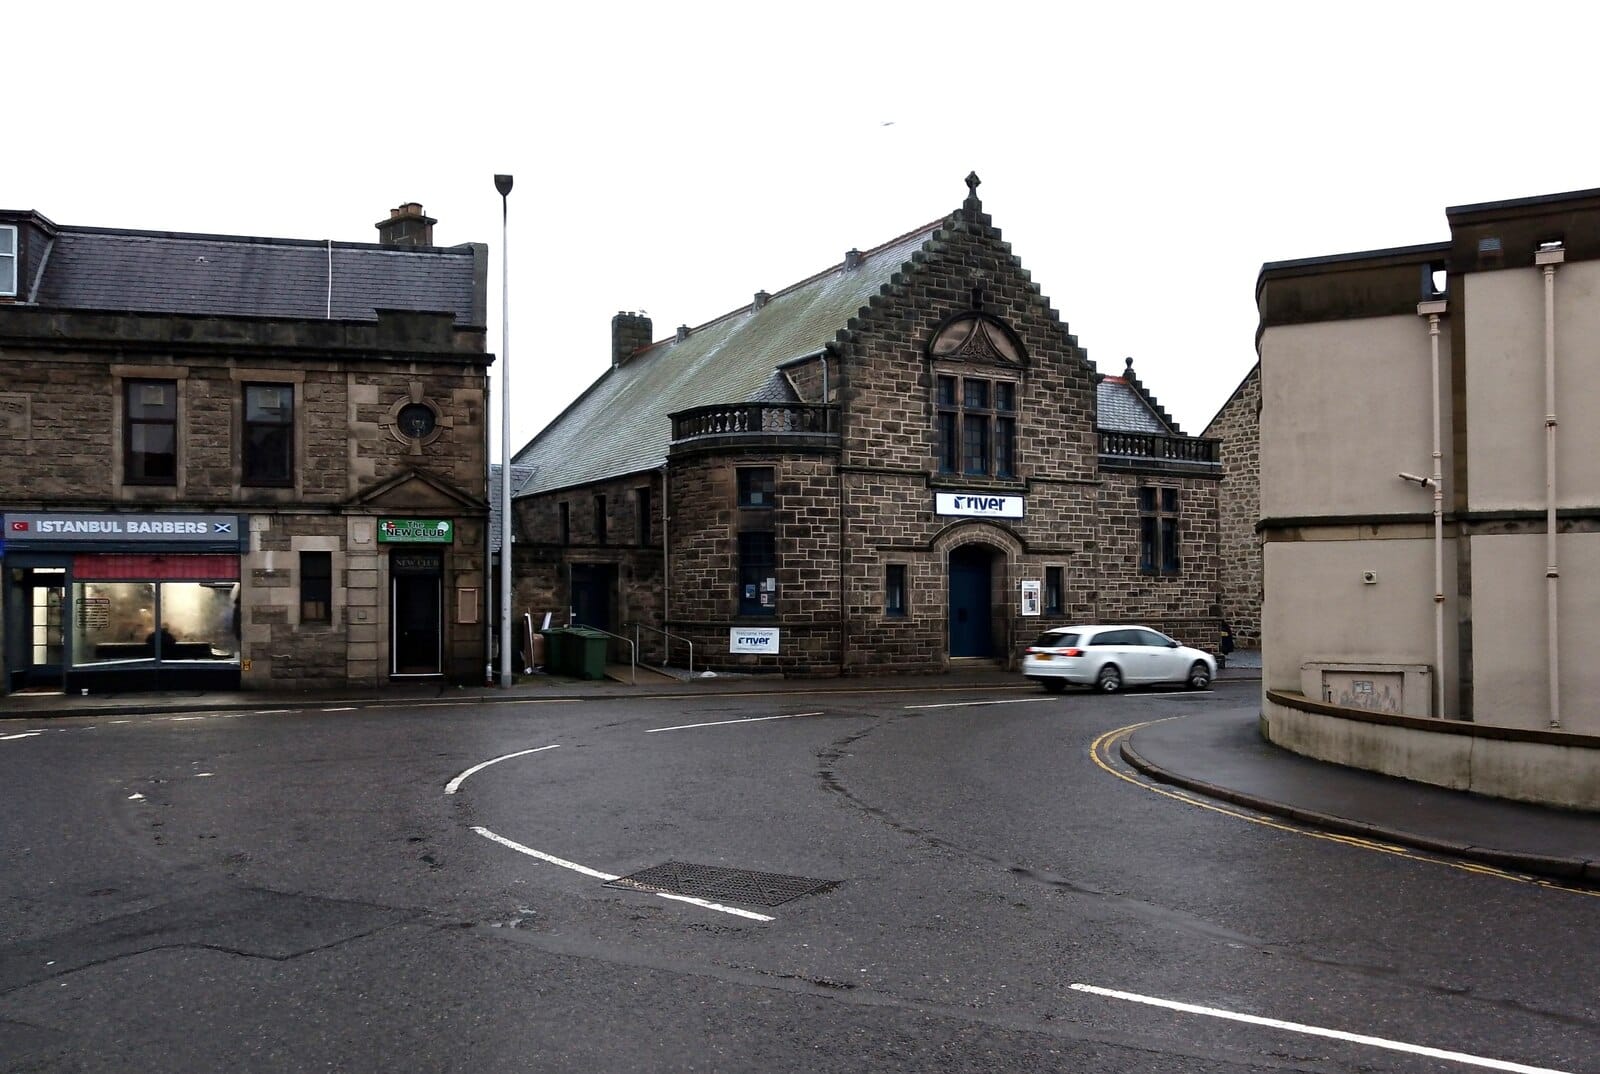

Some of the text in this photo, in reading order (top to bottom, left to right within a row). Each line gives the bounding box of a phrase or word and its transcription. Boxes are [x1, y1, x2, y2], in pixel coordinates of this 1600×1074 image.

[966, 496, 1006, 512] river
[36, 520, 208, 534] ISTANBUL BARBERS
[386, 528, 445, 537] NEW CLUB
